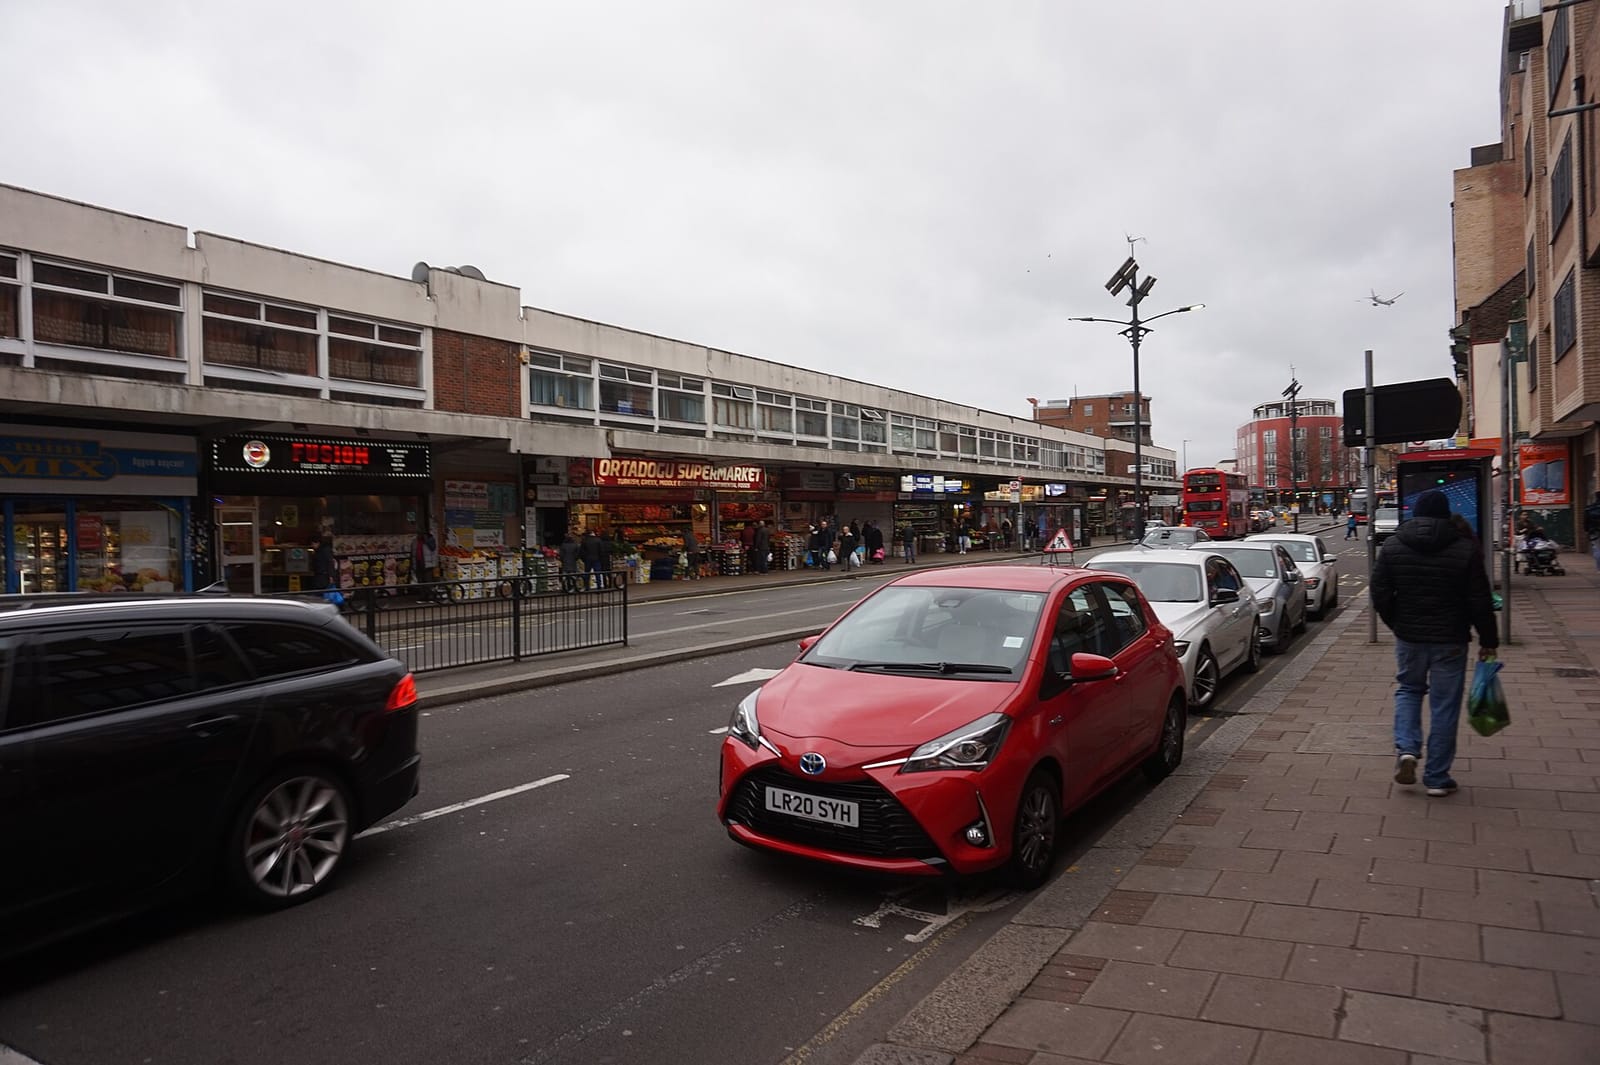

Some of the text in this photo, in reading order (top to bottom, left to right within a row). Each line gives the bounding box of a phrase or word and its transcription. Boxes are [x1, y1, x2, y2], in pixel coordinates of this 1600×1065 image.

[292, 443, 369, 464] FUSION
[600, 459, 762, 482] ORTADOGU SUPERMARKET
[772, 791, 851, 823] LR20 SYH
